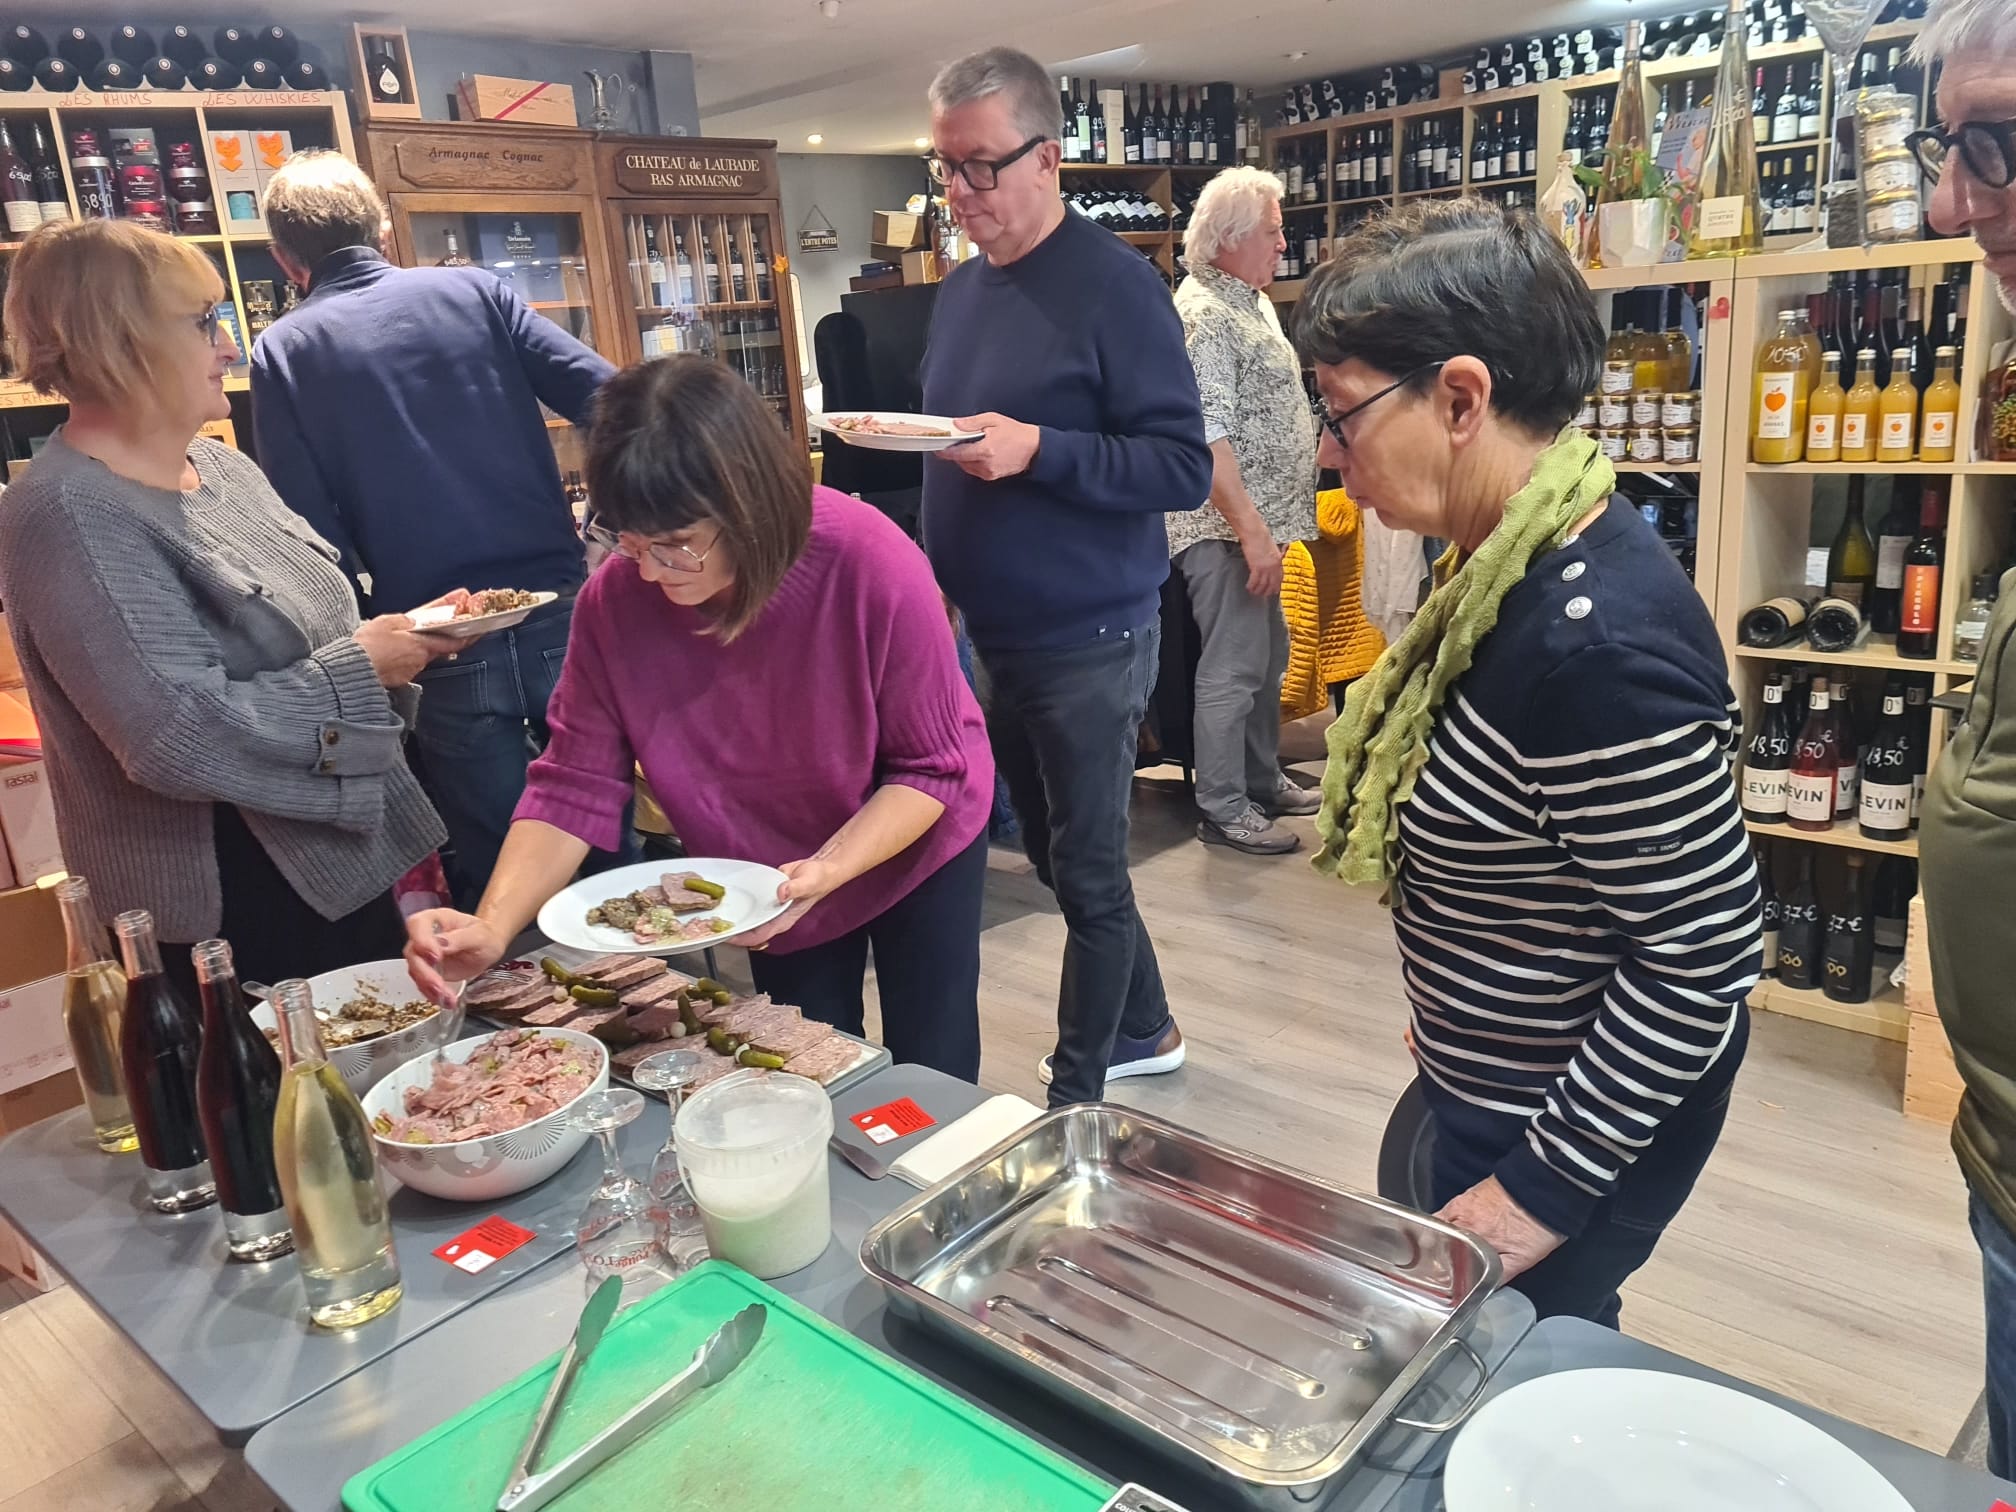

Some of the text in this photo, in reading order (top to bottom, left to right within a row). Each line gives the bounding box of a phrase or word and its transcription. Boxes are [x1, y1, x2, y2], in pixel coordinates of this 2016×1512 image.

[59, 92, 153, 106] LES RHUMS
[202, 92, 321, 106] LES WHISKIES
[428, 147, 544, 164] Armagnac Cognac
[626, 154, 760, 172] CHATEAU de LAUBADE
[651, 173, 743, 188] BAS ARMAGNAC
[1860, 795, 1907, 810] LEVIN
